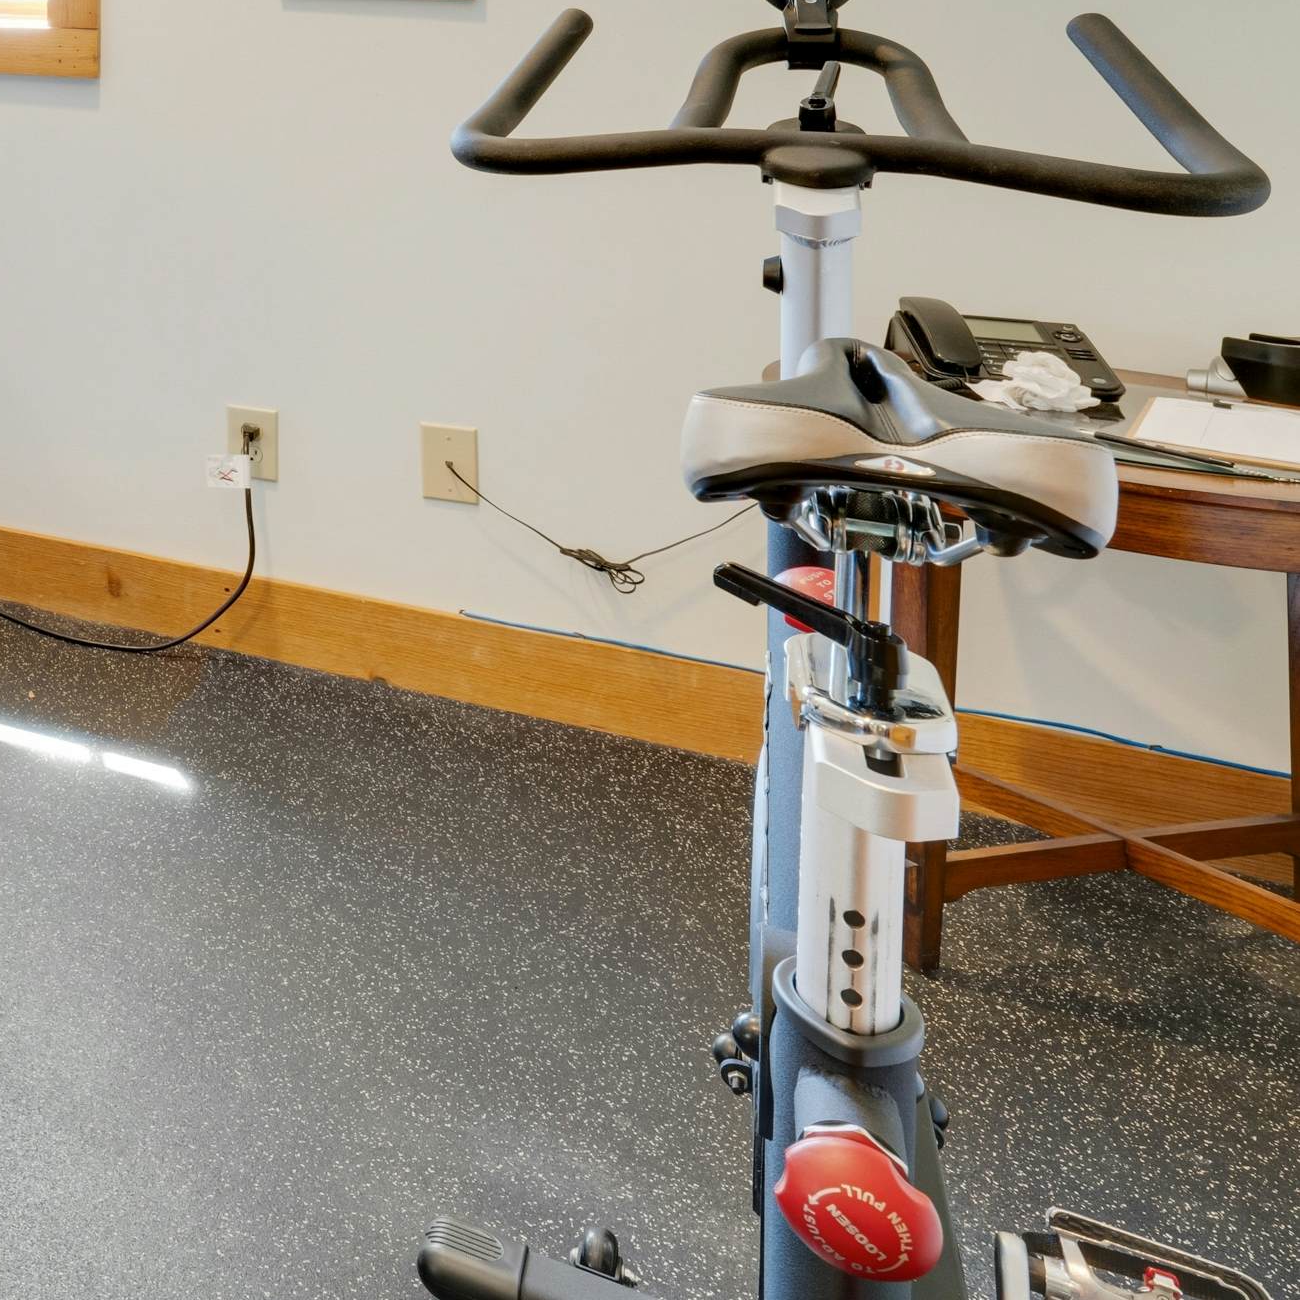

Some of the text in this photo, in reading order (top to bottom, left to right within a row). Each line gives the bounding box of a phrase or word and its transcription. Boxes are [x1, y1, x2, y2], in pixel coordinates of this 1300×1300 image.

[802, 1203, 878, 1274] TO ADJUST
[825, 1203, 888, 1262] LOOSEN
[840, 1183, 913, 1252] THEN PULL
